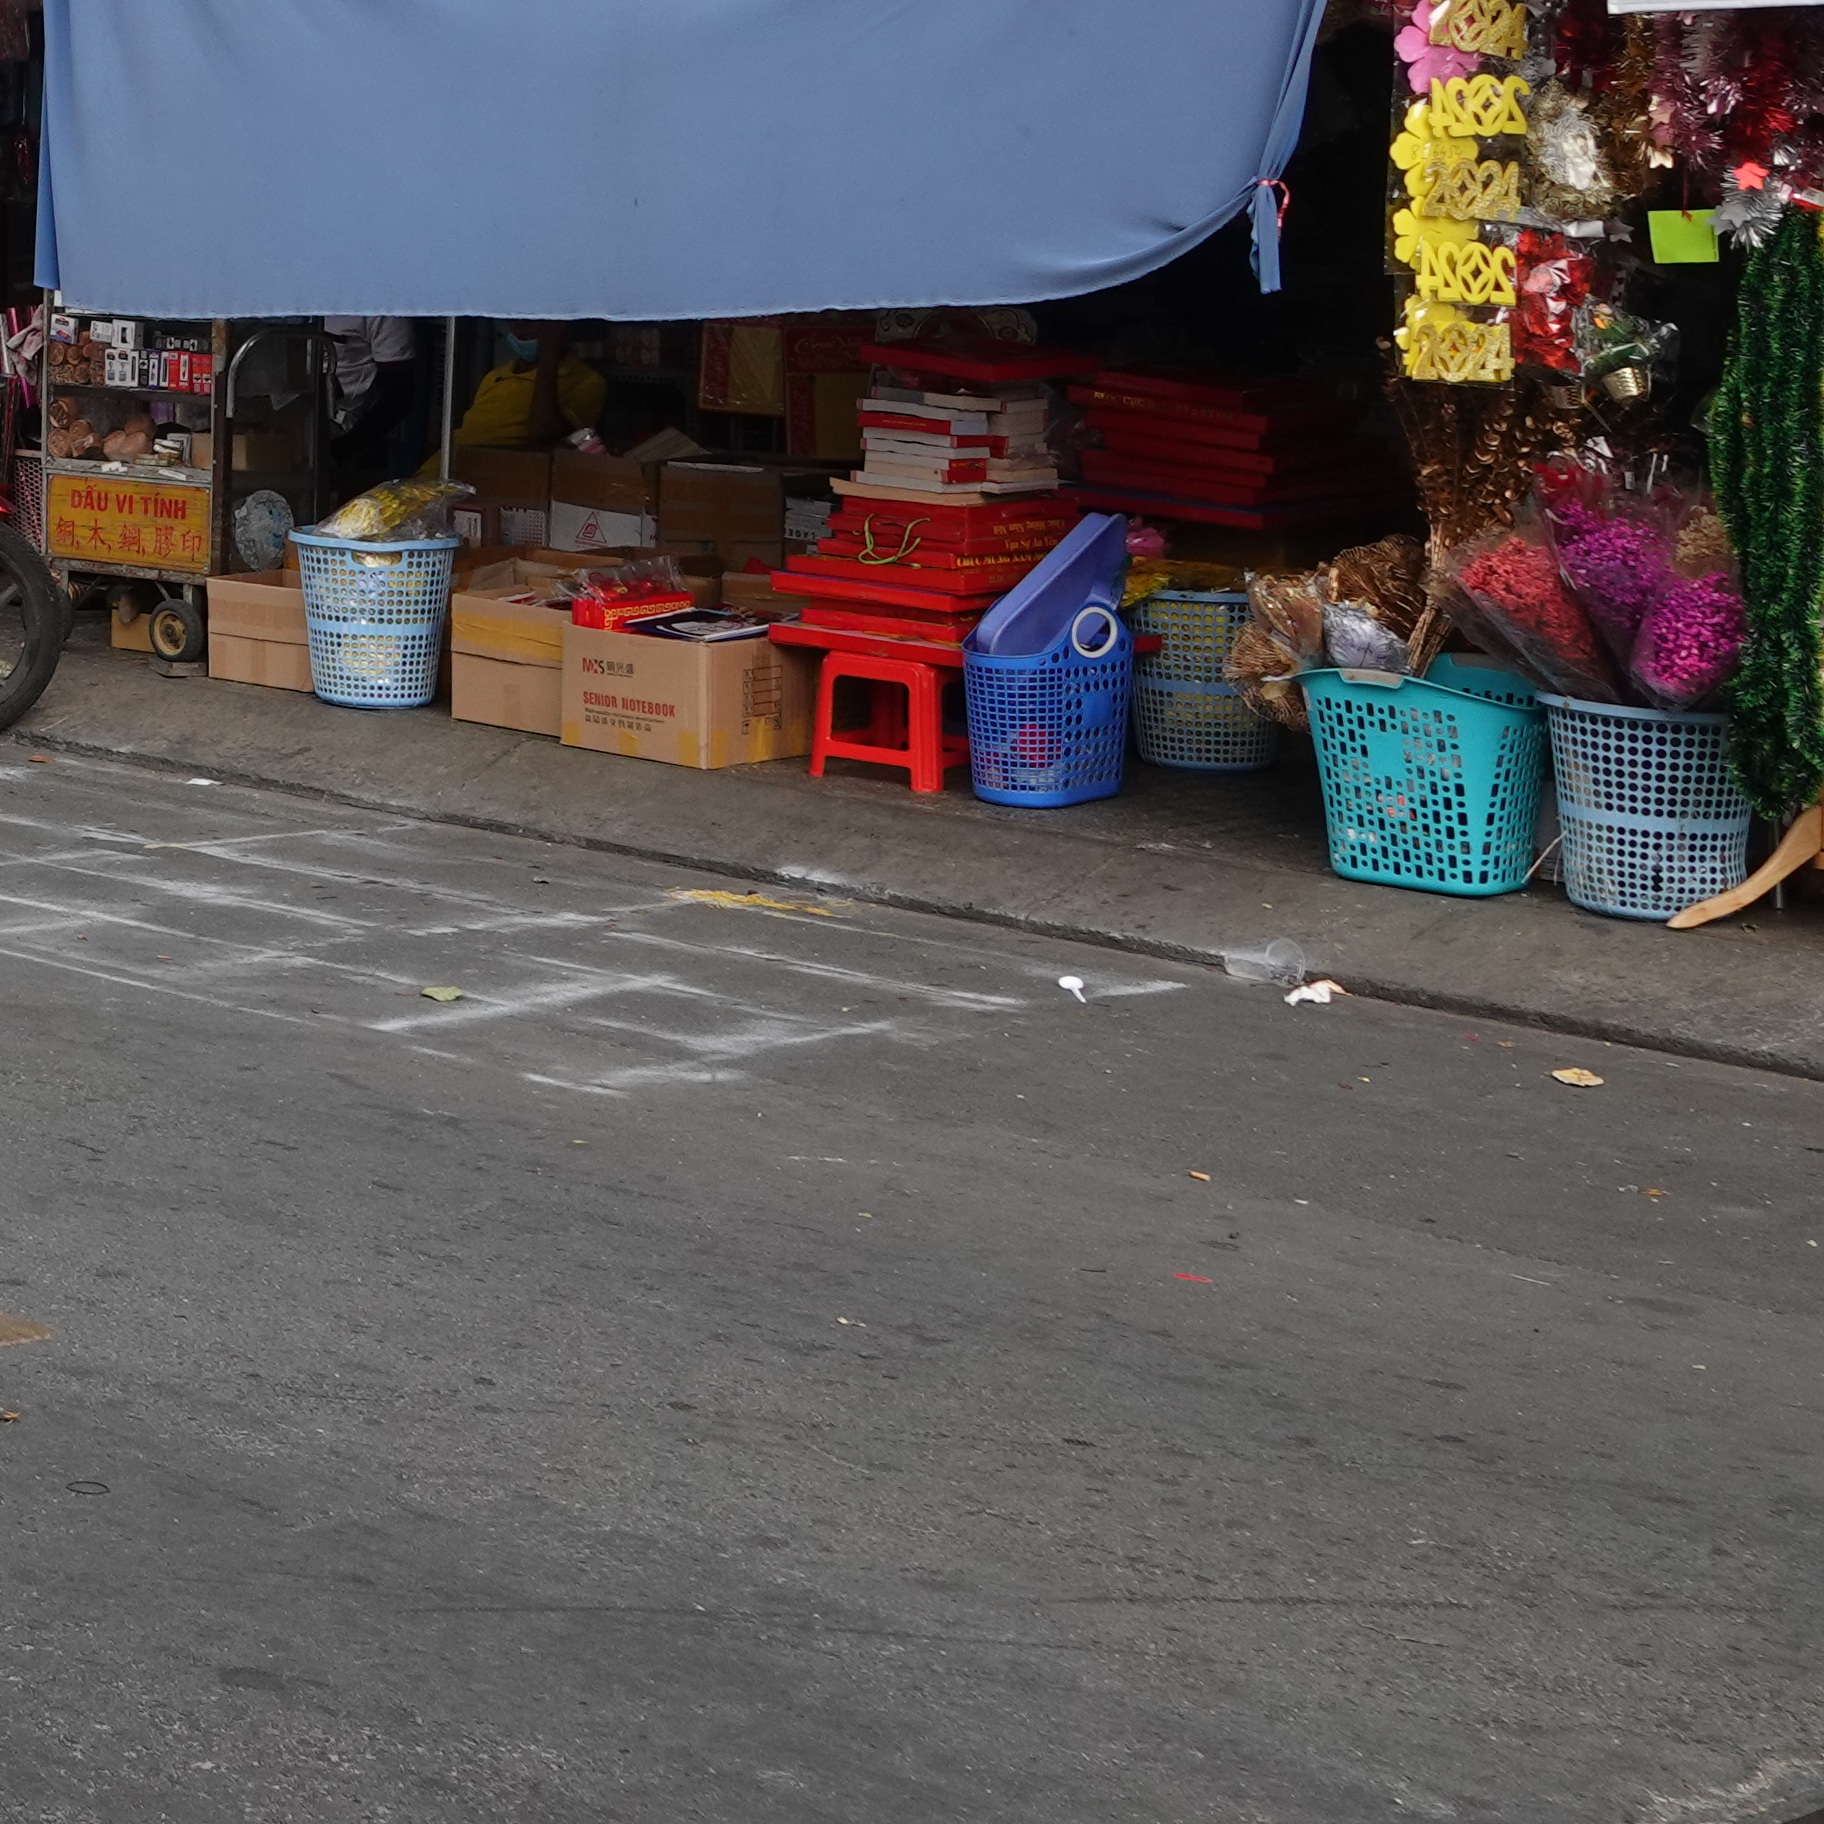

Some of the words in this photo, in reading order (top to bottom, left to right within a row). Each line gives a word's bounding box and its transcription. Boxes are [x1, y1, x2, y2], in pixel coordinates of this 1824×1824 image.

[70, 483, 109, 512] DẤU
[115, 493, 135, 515] VI
[140, 491, 187, 520] TÍNH
[583, 691, 618, 709] SENIOR
[621, 696, 676, 718] NOTEBOOK
